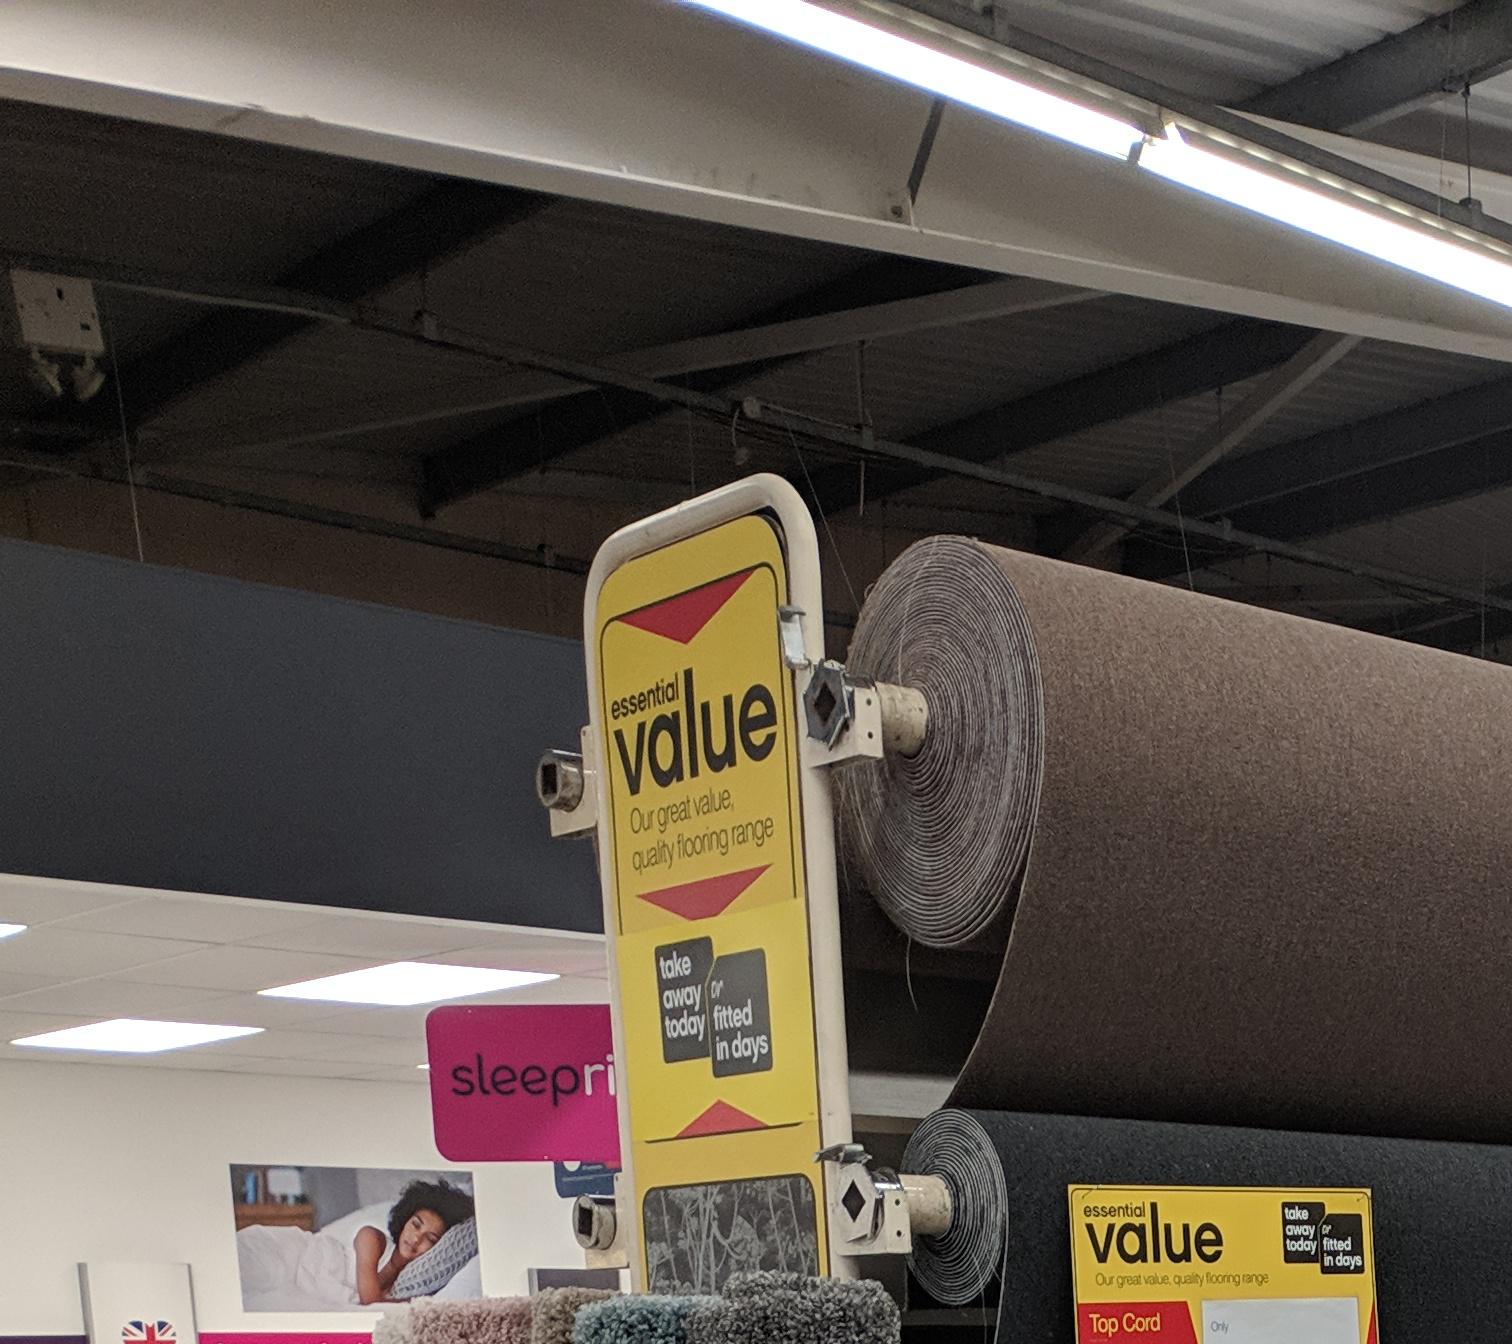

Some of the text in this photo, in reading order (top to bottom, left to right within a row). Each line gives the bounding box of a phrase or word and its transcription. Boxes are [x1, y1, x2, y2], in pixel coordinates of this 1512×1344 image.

[611, 672, 679, 720] essential
[613, 667, 777, 796] value
[630, 807, 655, 834] Our
[657, 795, 691, 834] great
[633, 817, 774, 875] quality flooring range
[660, 950, 691, 979] take
[663, 984, 701, 1012] away
[710, 980, 724, 999] or
[665, 1009, 705, 1041] today
[713, 998, 753, 1031] fitted
[716, 1031, 769, 1063] in days
[1083, 1201, 1145, 1218] essential
[1284, 1206, 1309, 1220] take
[1085, 1202, 1224, 1264] value
[1286, 1225, 1315, 1239] away
[1323, 1237, 1351, 1251] fitted
[1286, 1237, 1317, 1255] today
[1324, 1252, 1362, 1270] in days
[1096, 1272, 1114, 1286] Our
[1116, 1273, 1142, 1288] great
[1174, 1272, 1205, 1287] quality
[1242, 1273, 1269, 1288] range
[1089, 1312, 1161, 1337] Top Cord
[1211, 1320, 1229, 1334] Only
